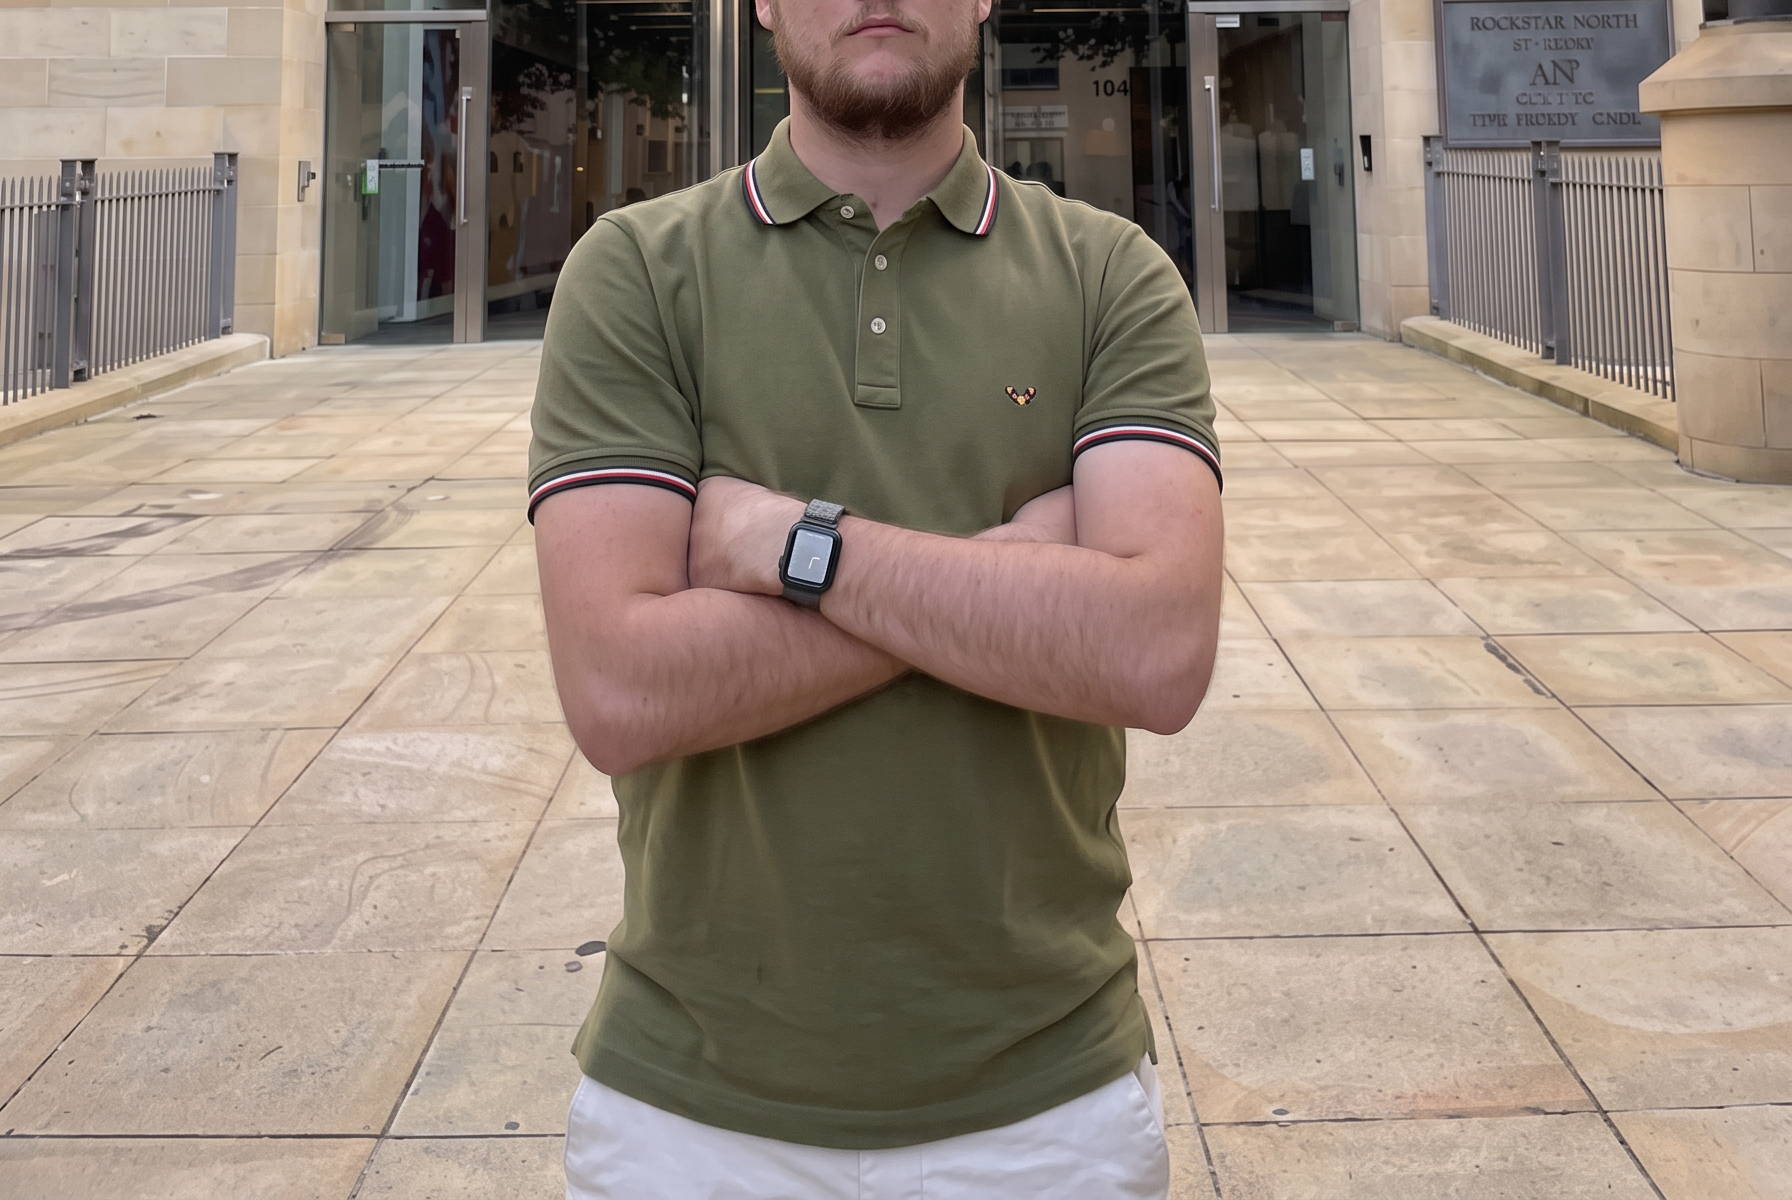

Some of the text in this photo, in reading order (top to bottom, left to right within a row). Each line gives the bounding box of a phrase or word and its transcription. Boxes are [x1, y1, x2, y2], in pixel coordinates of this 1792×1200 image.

[1470, 13, 1639, 31] ROCKSTAR NORTH
[1092, 79, 1129, 97] 104
